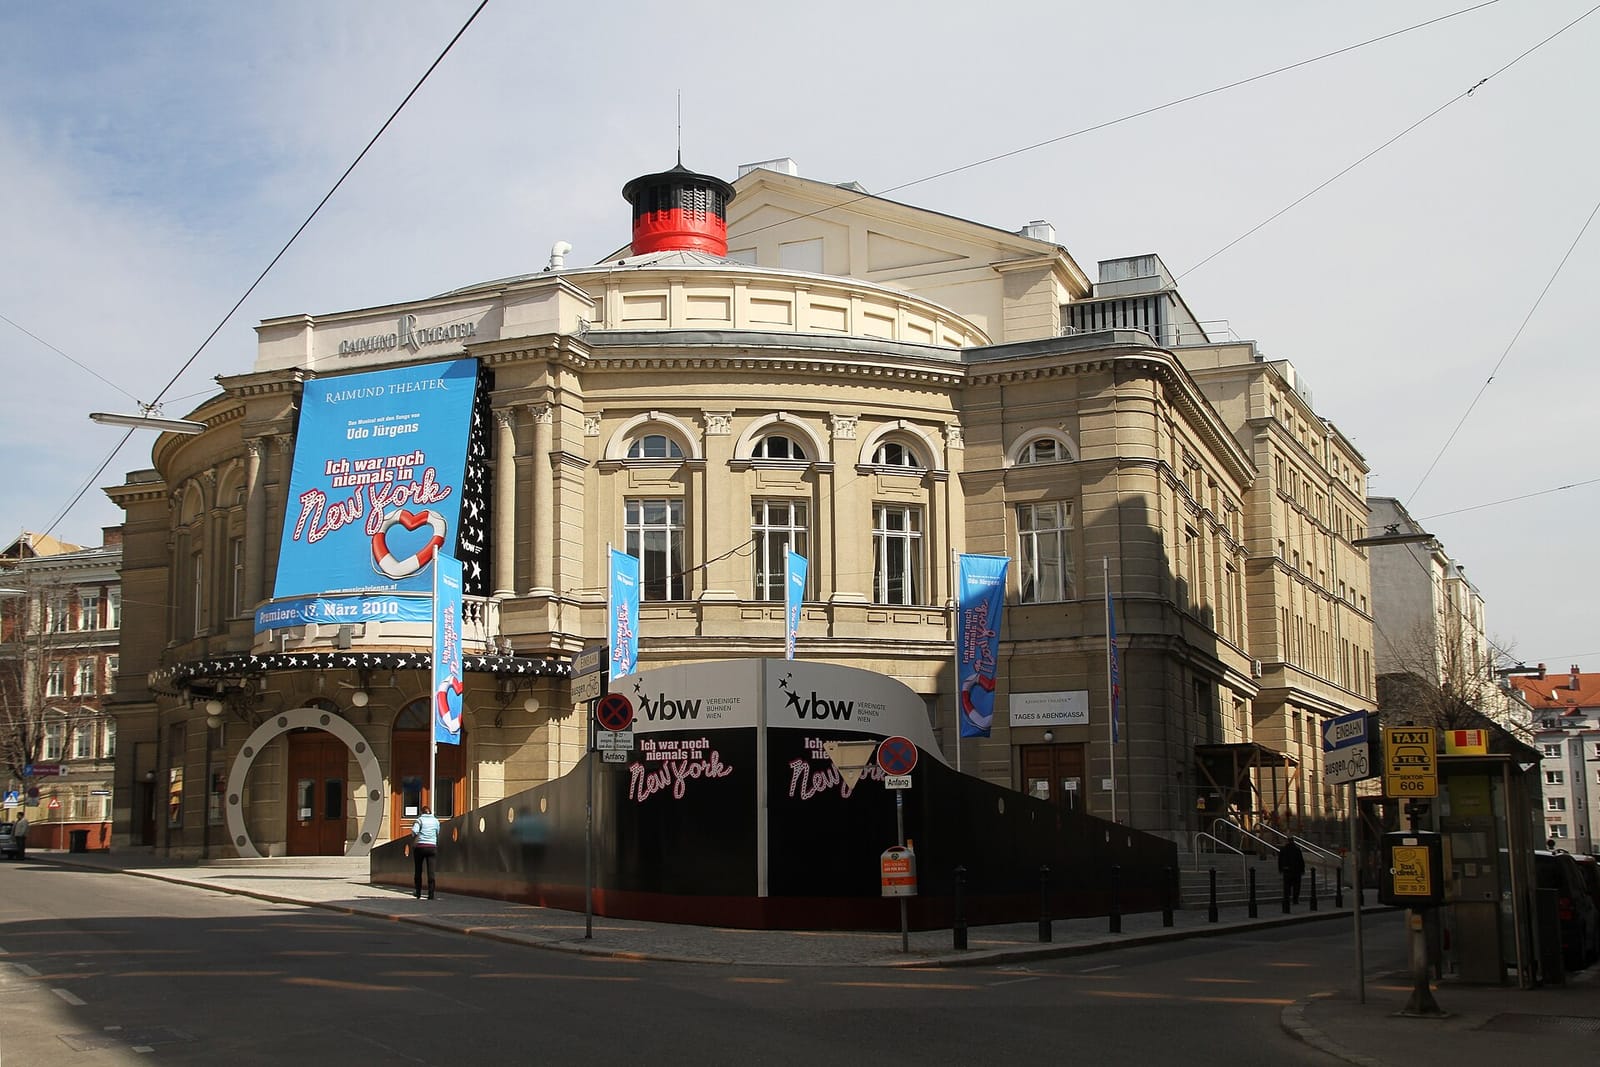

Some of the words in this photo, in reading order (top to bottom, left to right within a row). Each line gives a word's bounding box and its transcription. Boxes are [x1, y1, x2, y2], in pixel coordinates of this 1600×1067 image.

[340, 333, 396, 354] RAIMUND
[420, 322, 475, 344] THEATER
[326, 386, 385, 404] RAIMUND
[388, 379, 448, 394] THEATER
[346, 428, 369, 440] Udo
[372, 423, 419, 438] Jürgens
[325, 459, 350, 476] Ich
[355, 456, 383, 471] war
[387, 450, 424, 468] noch
[332, 469, 394, 488] niemals
[398, 466, 413, 480] in
[294, 486, 363, 543] New
[366, 468, 451, 536] York
[260, 610, 299, 624] Premiere:
[304, 605, 319, 617] 17.
[324, 603, 358, 617] März
[362, 601, 398, 615] 2010
[644, 693, 702, 721] vbw
[706, 697, 741, 705] VEREINIGTE
[706, 704, 732, 712] BÜHNEN
[793, 691, 854, 721] vbw
[1042, 711, 1085, 719] ABENDKASSA
[1336, 721, 1362, 740] EINBAHN
[1393, 733, 1427, 743] TAXI
[640, 739, 656, 751] Ich
[659, 739, 679, 750] war
[681, 737, 709, 749] noch
[804, 737, 823, 749] Ich
[605, 753, 625, 761] Anfang
[646, 750, 688, 761] niemals
[691, 748, 703, 759] in
[629, 761, 670, 802] New
[671, 751, 733, 799] York
[887, 778, 910, 787] Anfang
[1400, 781, 1424, 791] 606
